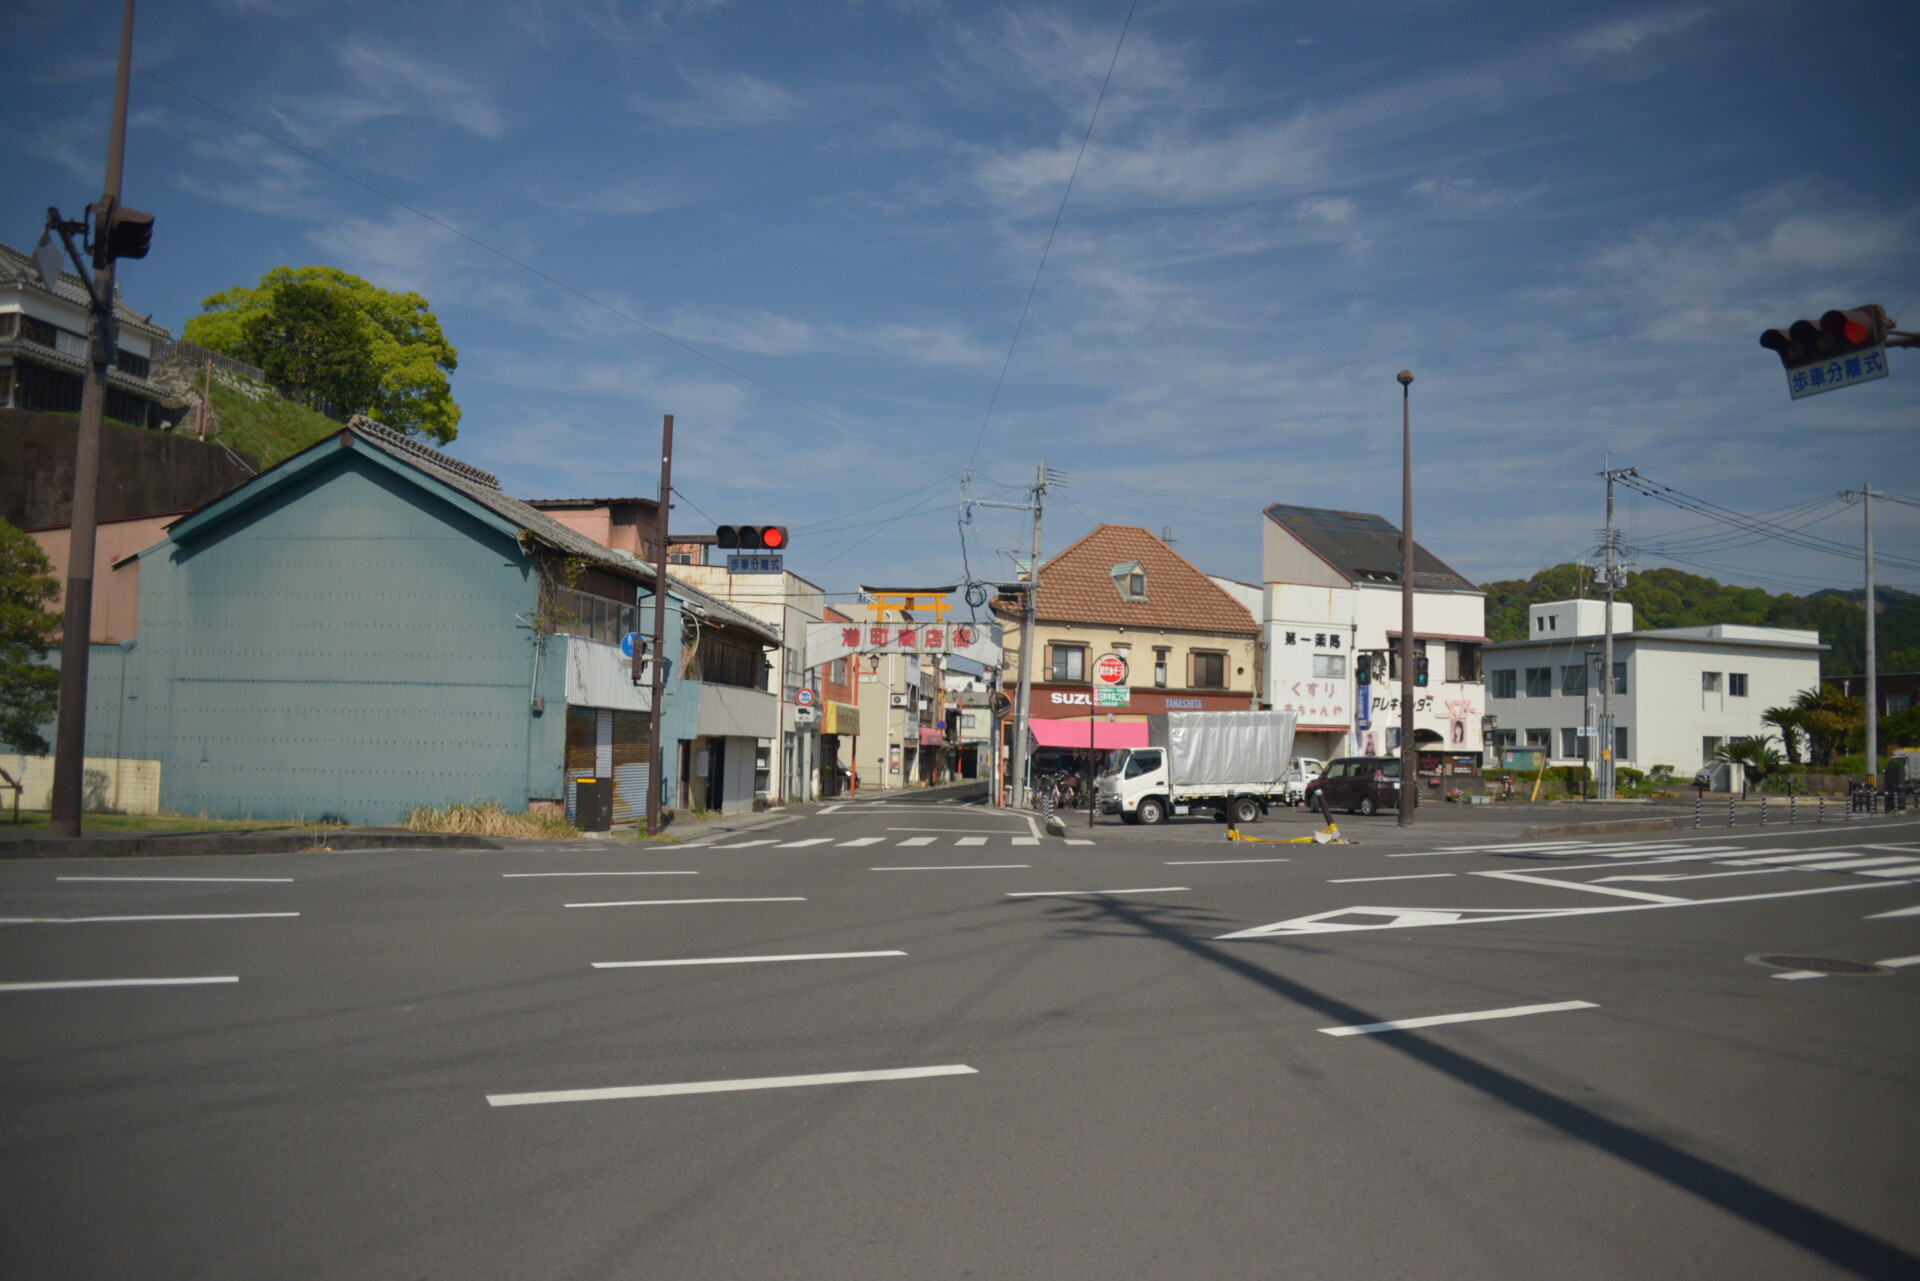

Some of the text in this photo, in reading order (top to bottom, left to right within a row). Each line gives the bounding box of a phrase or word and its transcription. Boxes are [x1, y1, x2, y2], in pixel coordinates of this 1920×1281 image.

[1791, 350, 1884, 393] 歩車分離式
[730, 558, 780, 571] 歩車分離式
[841, 627, 972, 648] 港町商店街
[1285, 630, 1341, 649] 第一薬局
[1291, 681, 1335, 699] くすり
[1165, 697, 1203, 710] YAMASHITA
